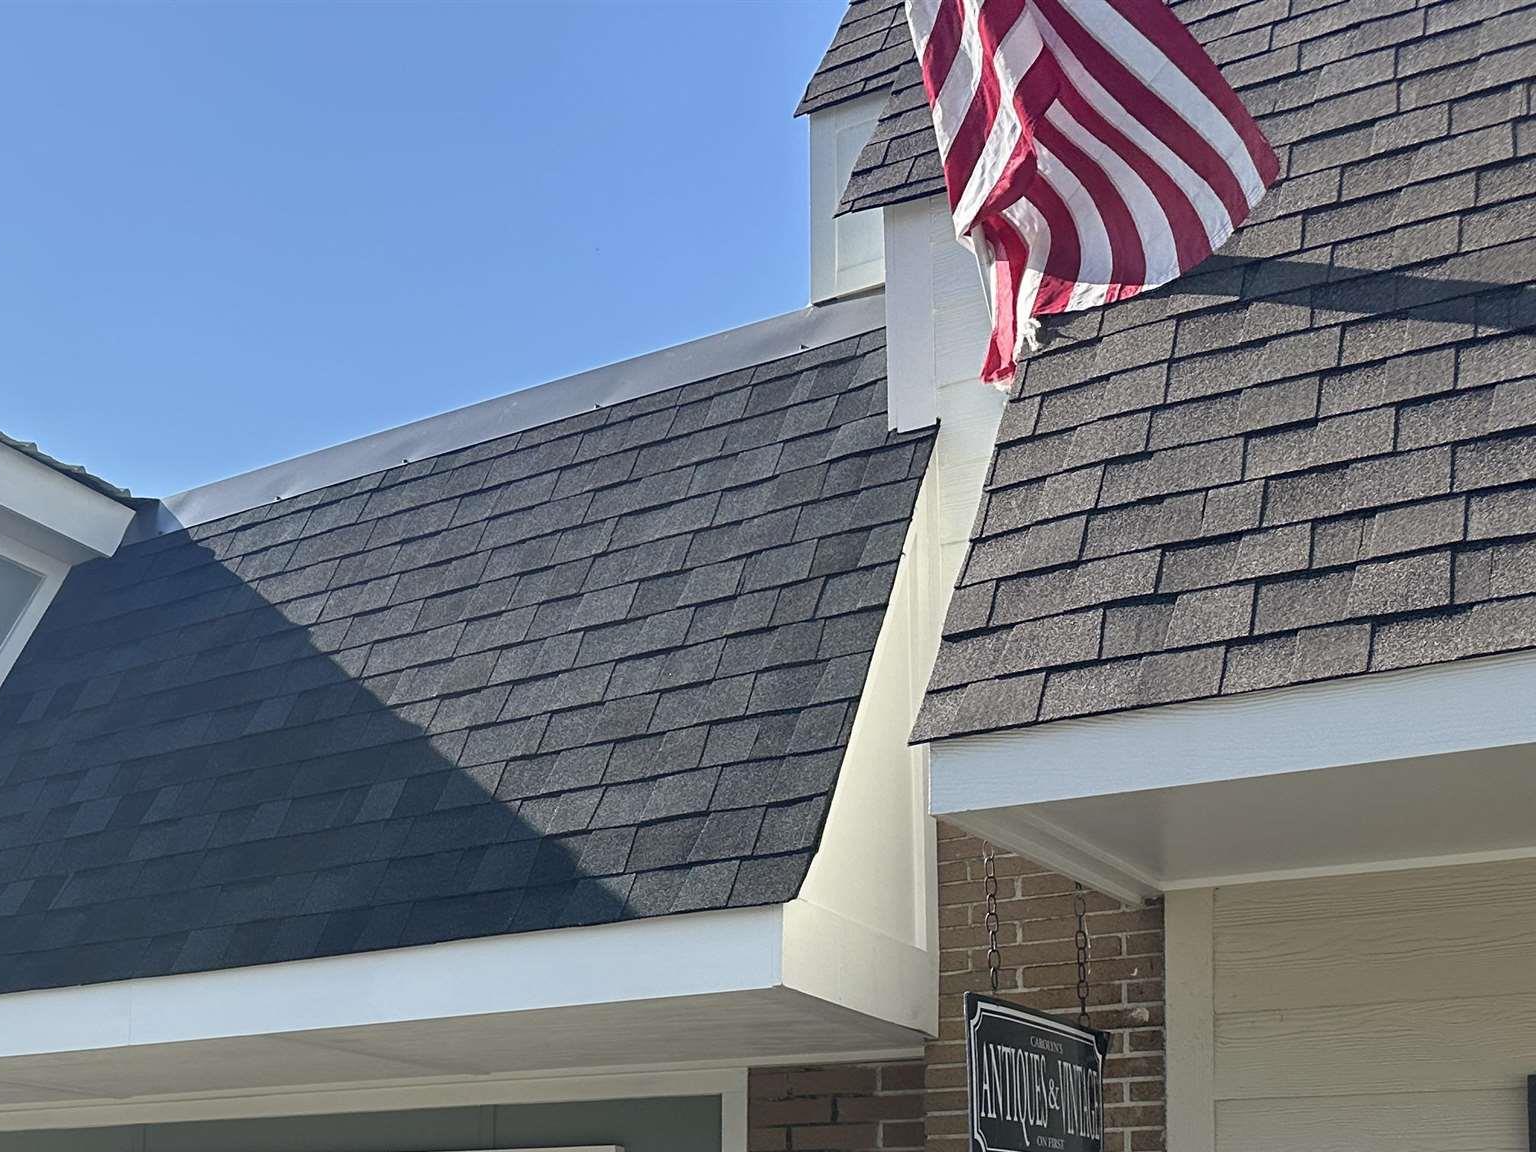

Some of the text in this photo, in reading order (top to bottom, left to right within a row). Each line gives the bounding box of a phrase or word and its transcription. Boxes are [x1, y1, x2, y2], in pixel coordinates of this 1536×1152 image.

[980, 1041, 1100, 1147] ANTIQUES & VINTAGE
[1036, 1135, 1064, 1150] ON FIRST
